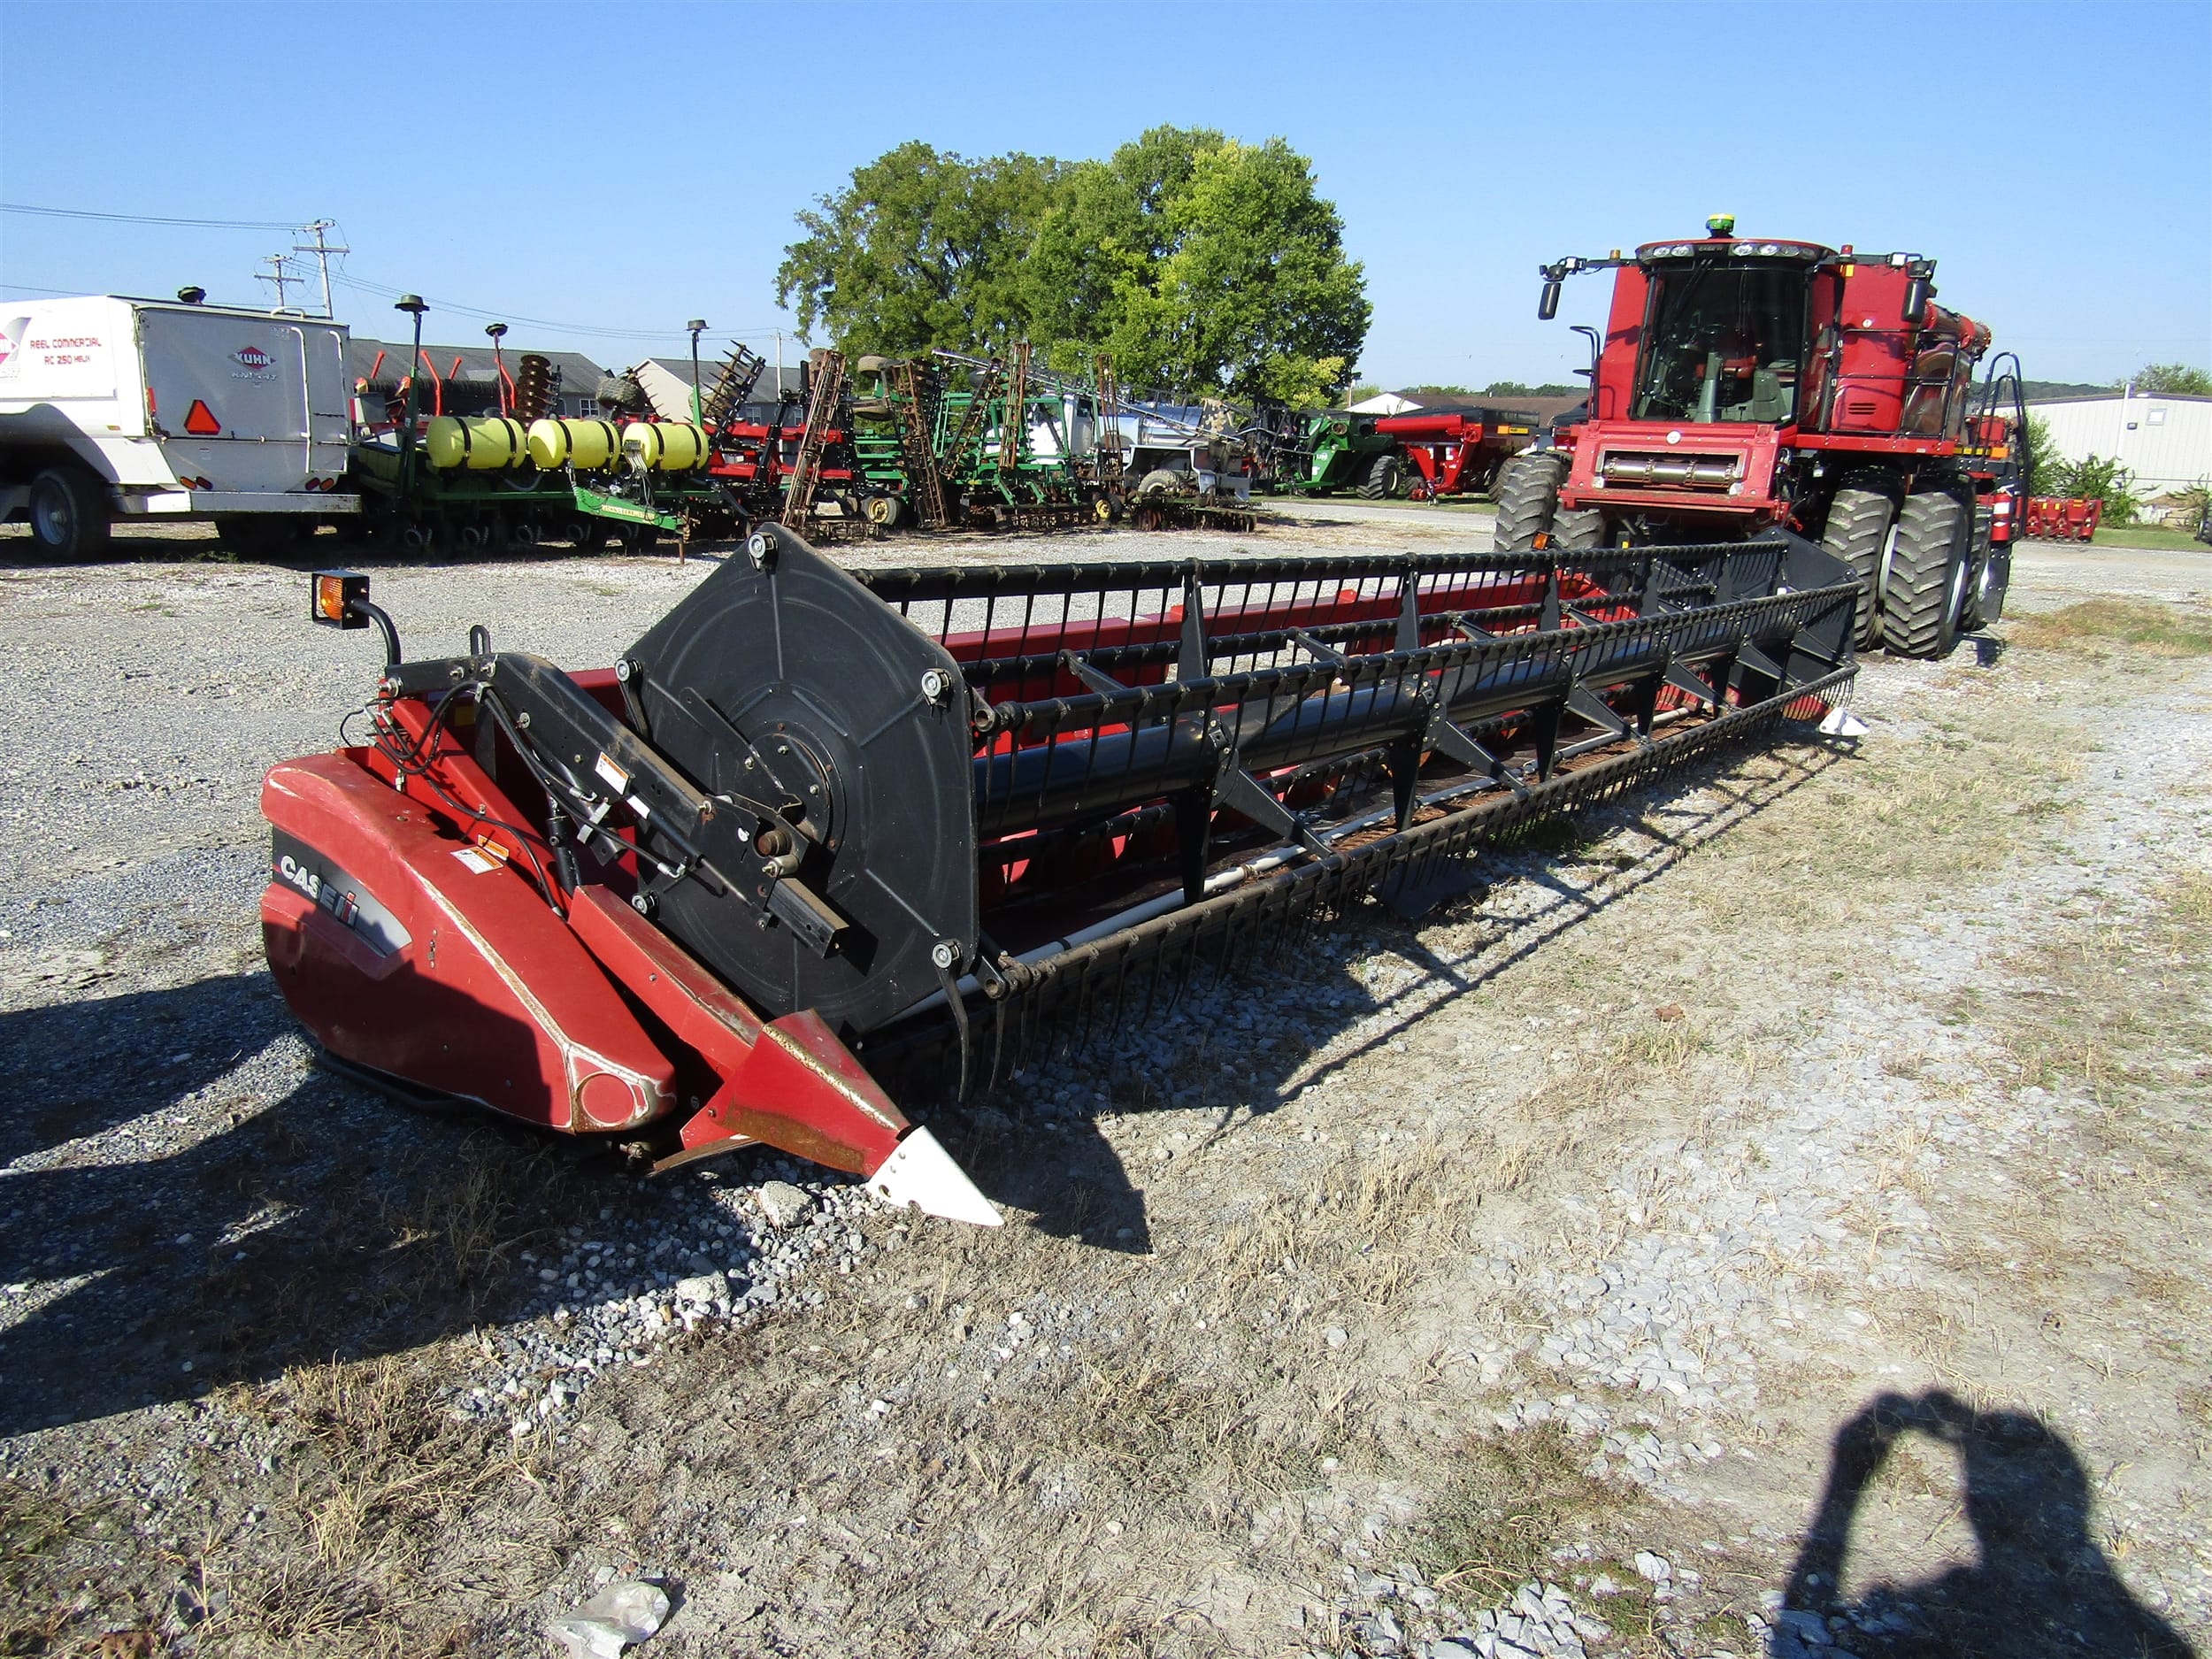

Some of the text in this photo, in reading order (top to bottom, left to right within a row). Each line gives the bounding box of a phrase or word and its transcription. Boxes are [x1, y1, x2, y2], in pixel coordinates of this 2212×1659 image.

[30, 338, 102, 349] REEL COMMERCIAL
[44, 356, 55, 365] RC
[57, 355, 73, 365] 250
[234, 352, 272, 365] KUHN
[280, 855, 338, 912] CASE
